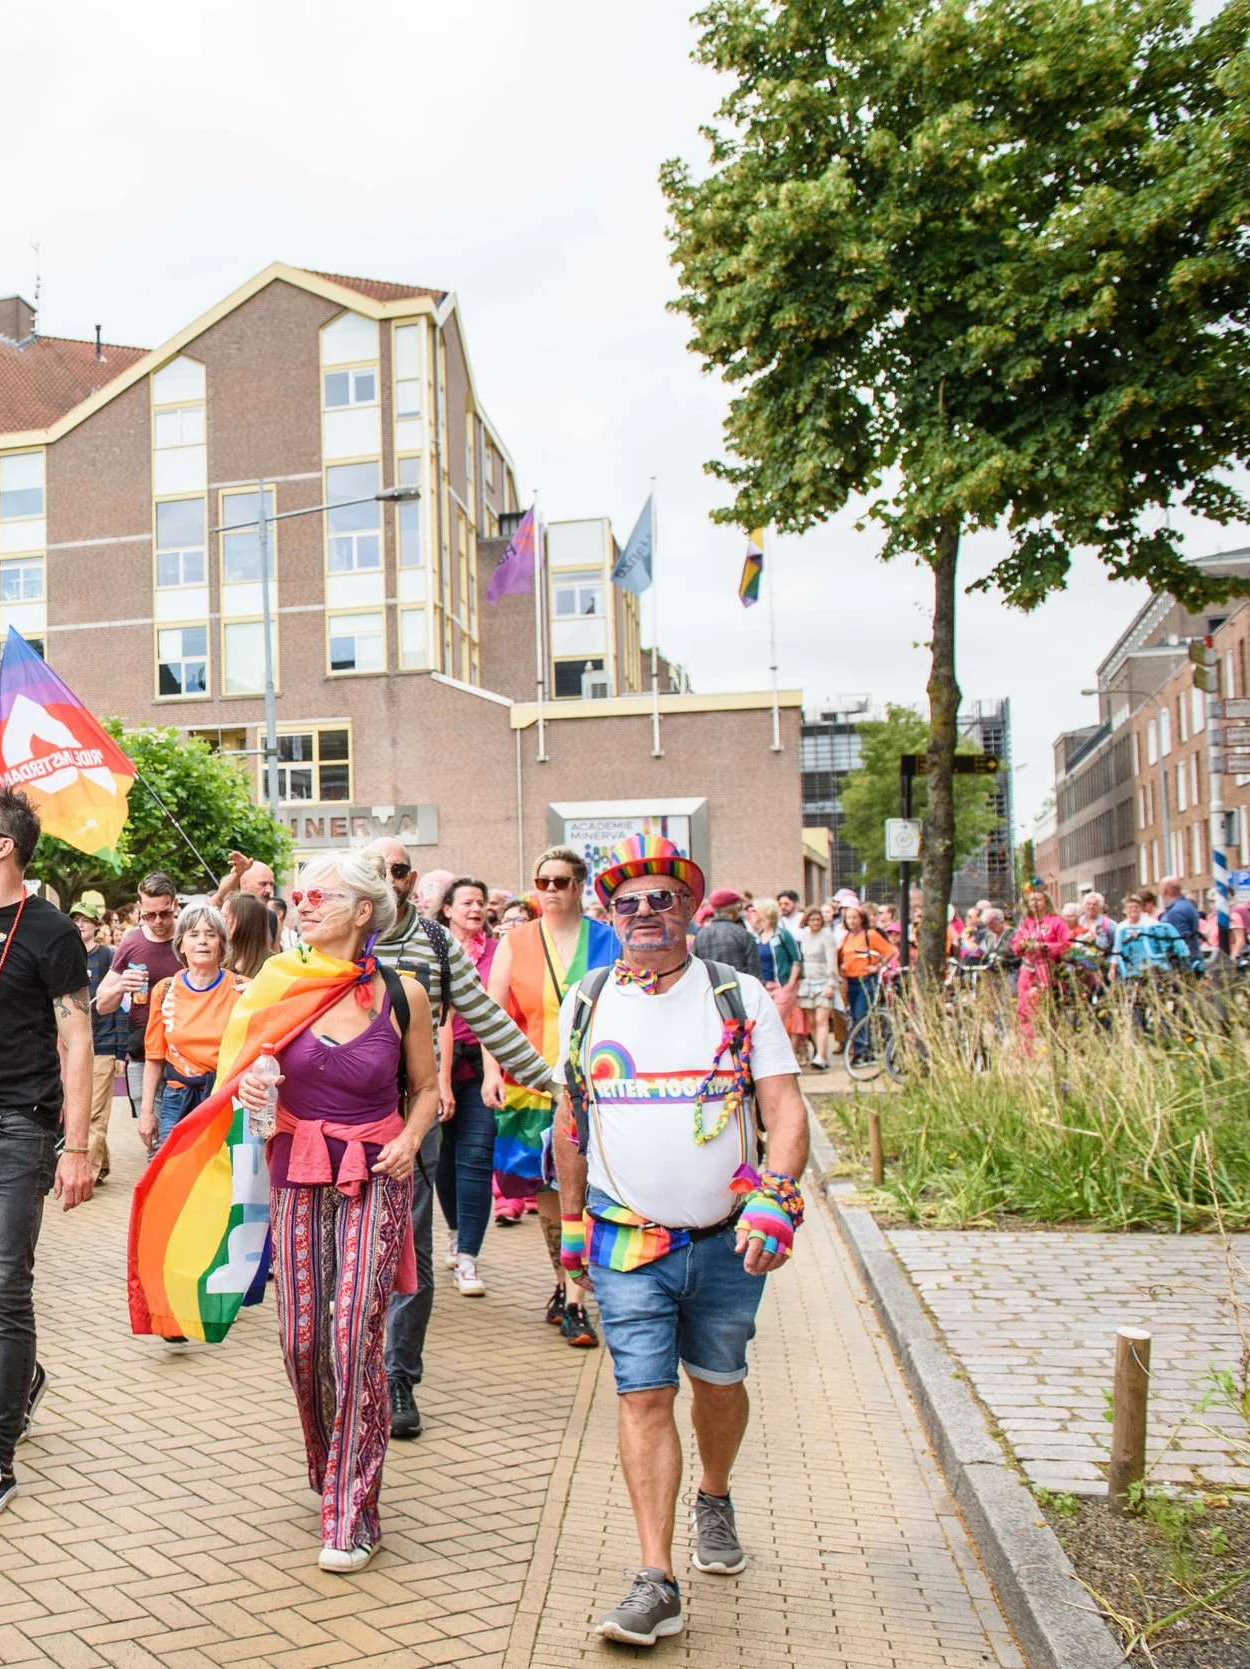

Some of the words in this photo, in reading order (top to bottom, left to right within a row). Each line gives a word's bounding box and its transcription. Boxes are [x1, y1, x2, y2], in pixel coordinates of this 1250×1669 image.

[279, 813, 417, 839] INERVA
[571, 821, 634, 831] ACADEMIE
[570, 831, 627, 840] MINERVA
